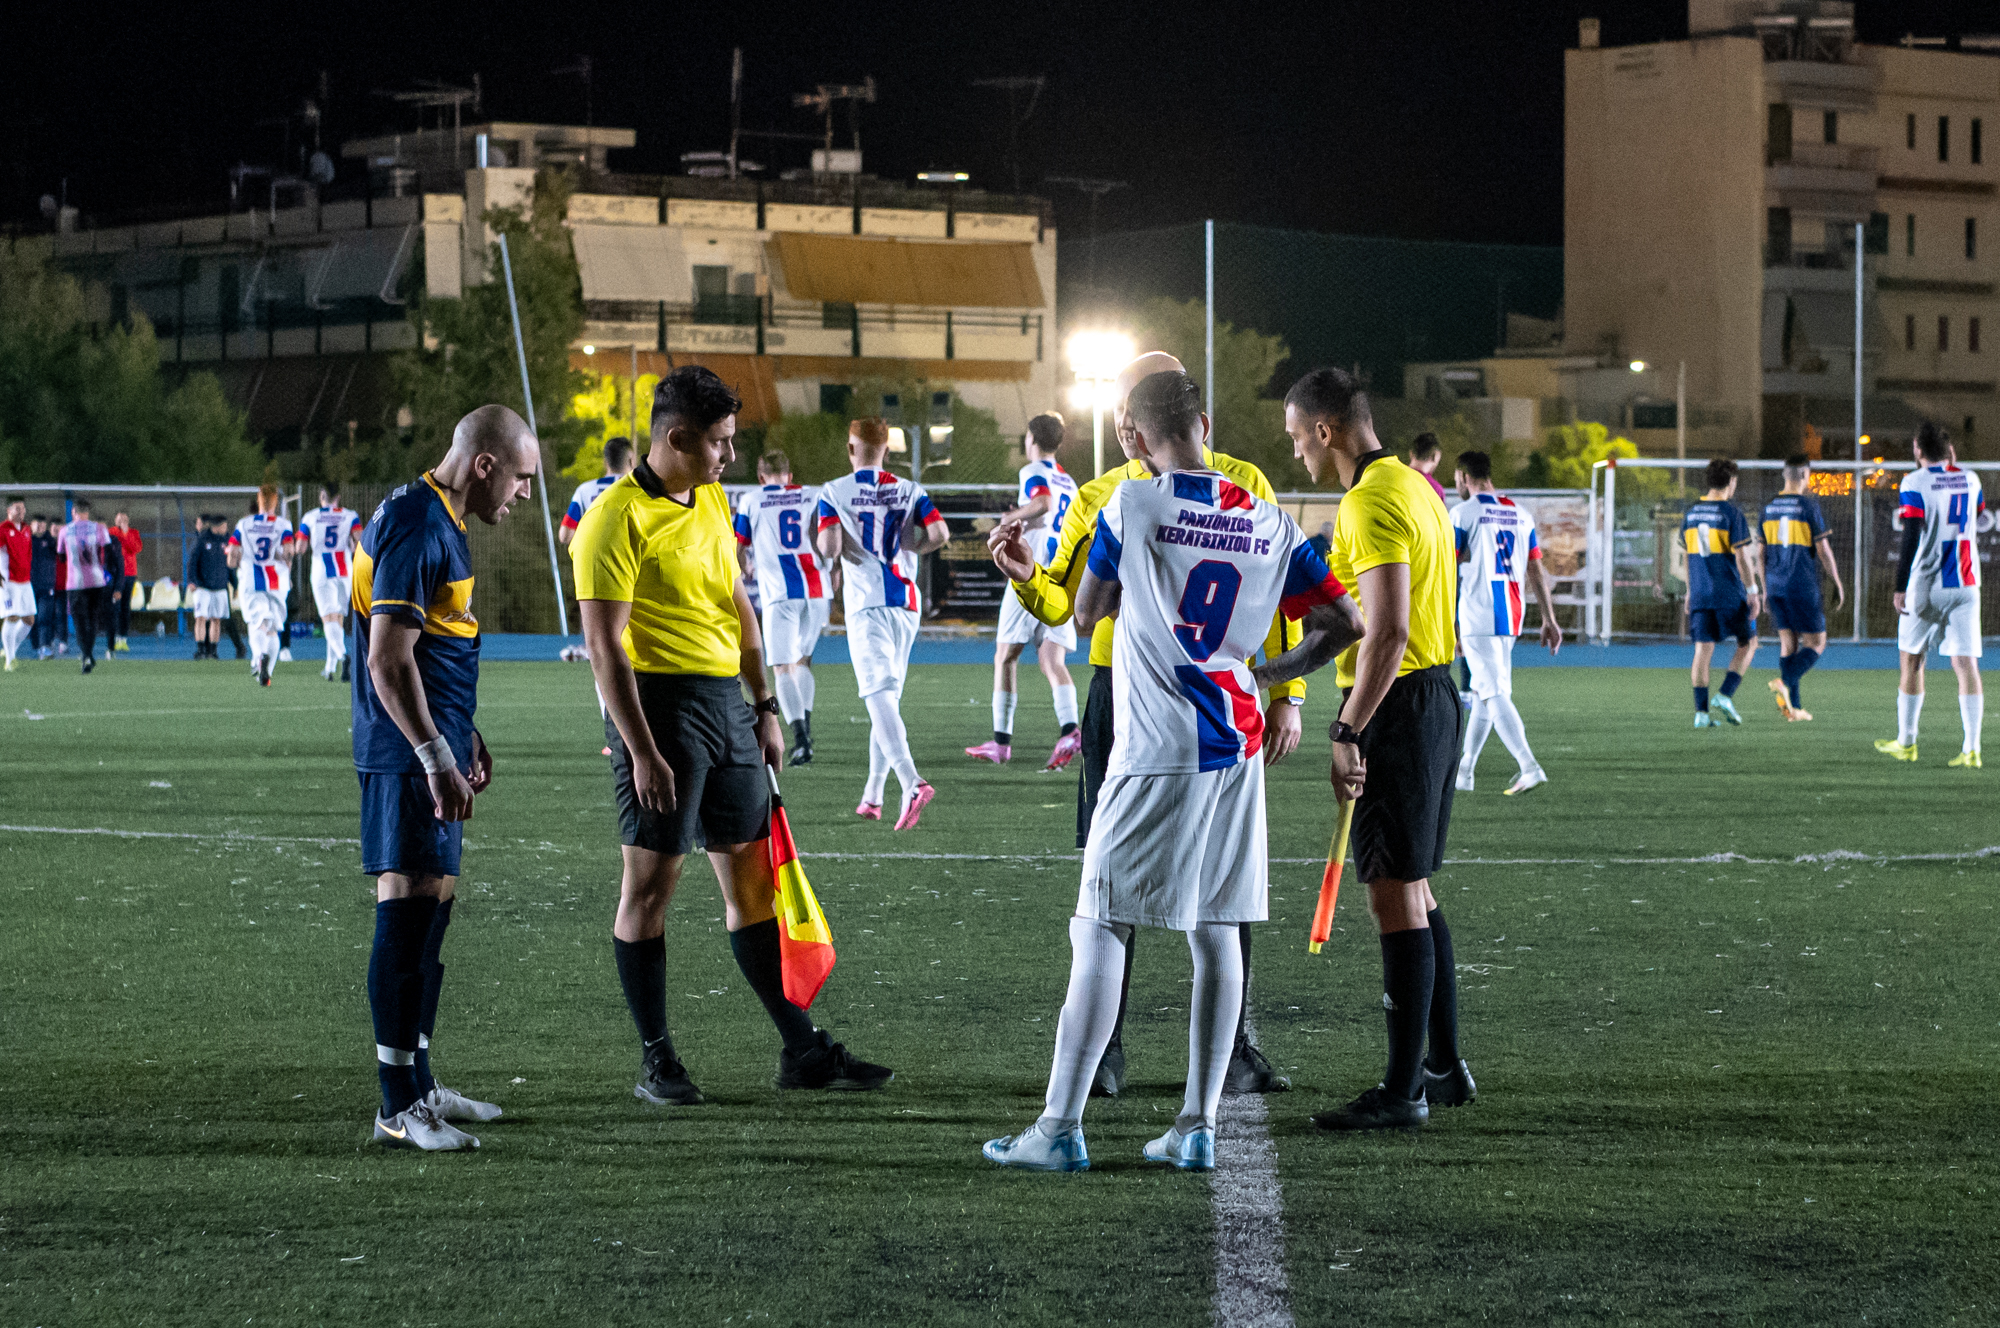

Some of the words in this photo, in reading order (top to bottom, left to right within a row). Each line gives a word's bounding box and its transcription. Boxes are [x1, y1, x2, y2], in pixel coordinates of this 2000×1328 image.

[778, 509, 801, 550] 6
[1052, 493, 1071, 533] 8
[1177, 509, 1253, 534] PANIONIOS
[1946, 492, 1969, 534] 4
[254, 537, 272, 562] 3
[324, 525, 339, 549] 5
[858, 509, 907, 562] 10
[1155, 525, 1251, 554] KERATSINIOU
[1253, 538, 1271, 556] FC
[1173, 558, 1242, 664] 9
